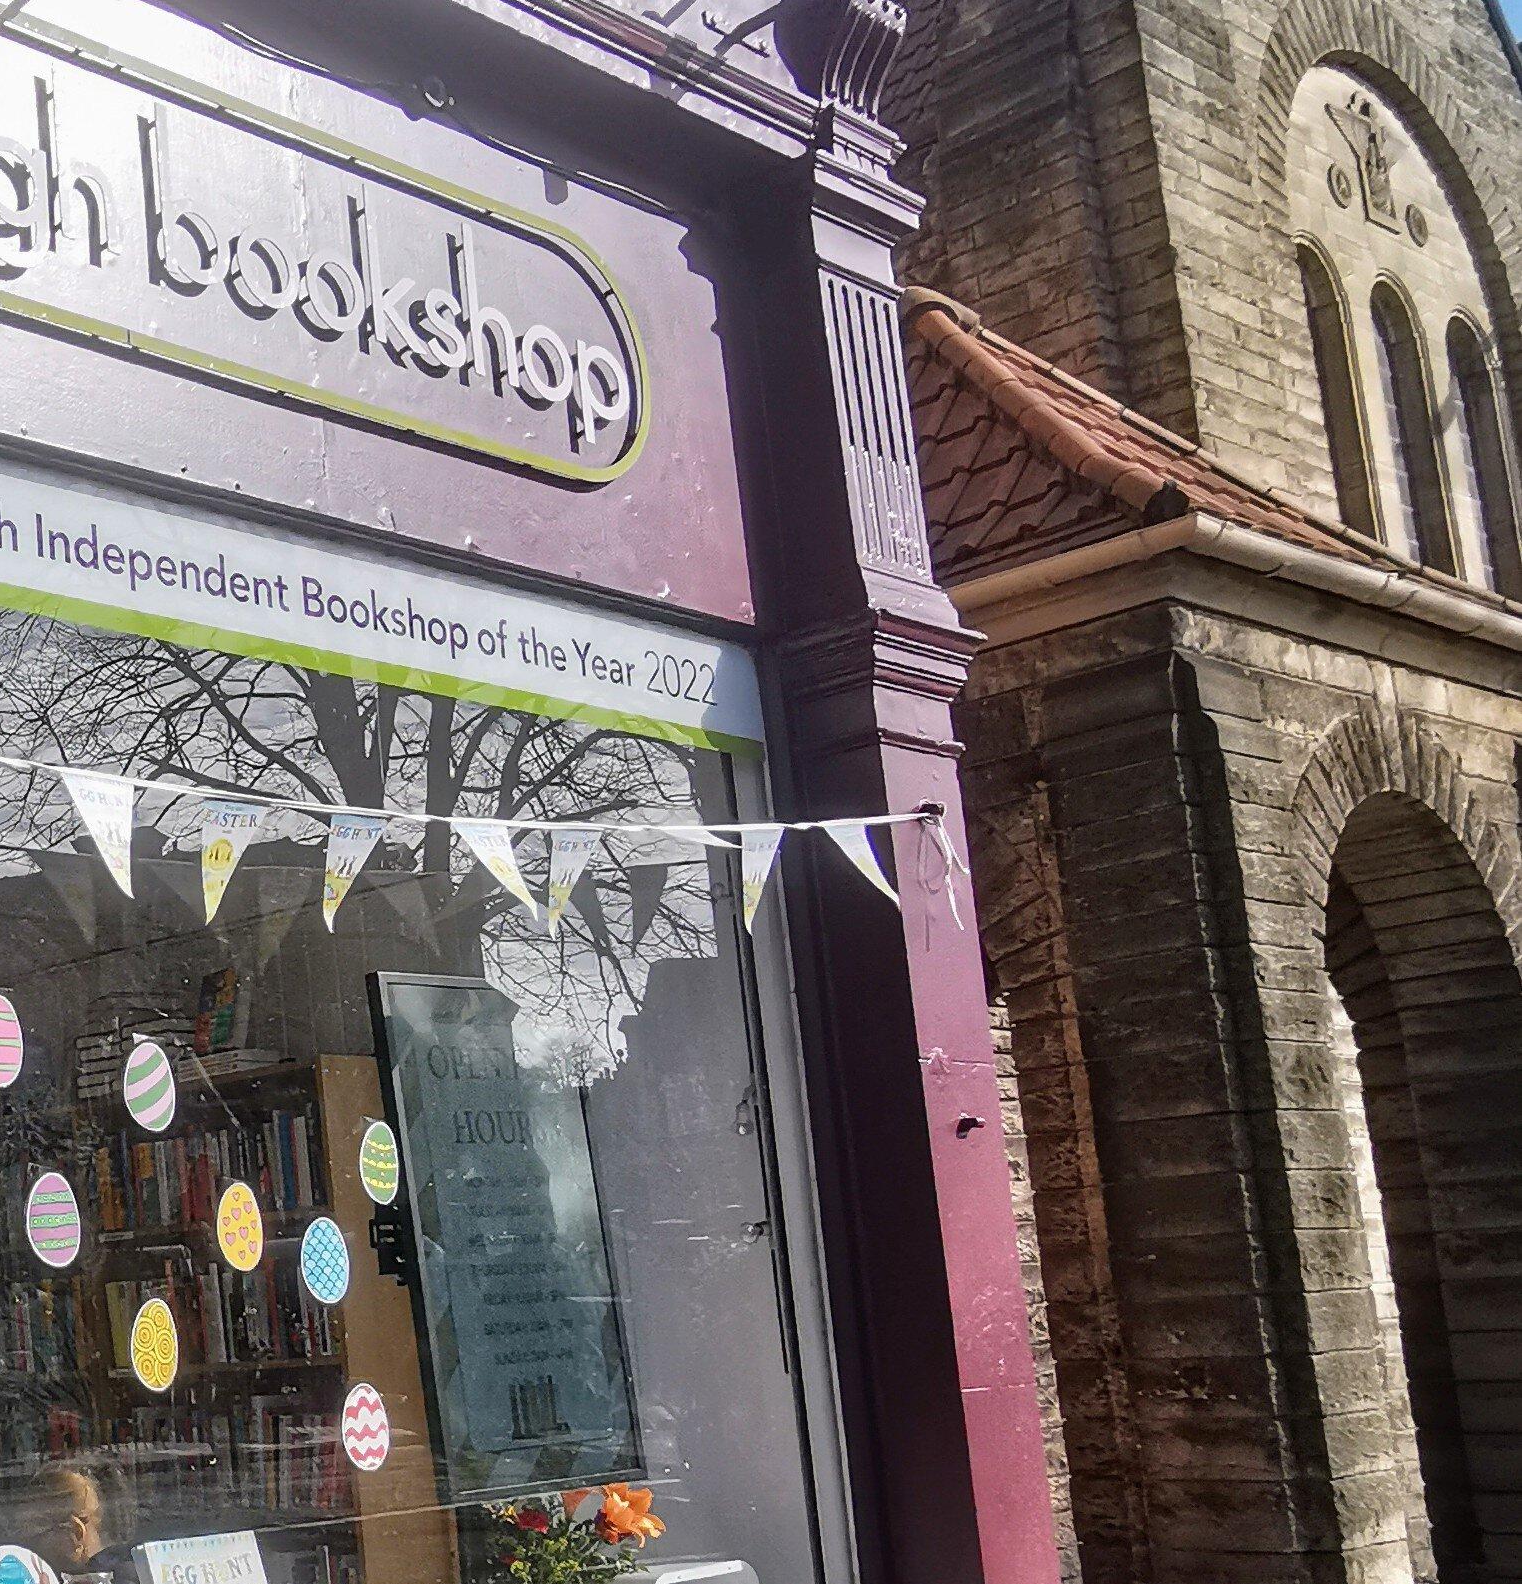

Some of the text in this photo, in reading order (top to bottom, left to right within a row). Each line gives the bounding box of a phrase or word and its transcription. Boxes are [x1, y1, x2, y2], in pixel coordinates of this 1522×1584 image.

[144, 103, 629, 445] bookshop
[36, 513, 288, 612] Independent
[301, 575, 469, 659] Bookshop
[477, 619, 508, 659] of
[517, 626, 567, 672] the
[572, 638, 635, 688] Year
[643, 650, 718, 706] 2022
[203, 808, 258, 828] EASTER
[351, 826, 382, 840] HNT
[452, 1106, 544, 1146] HOUR
